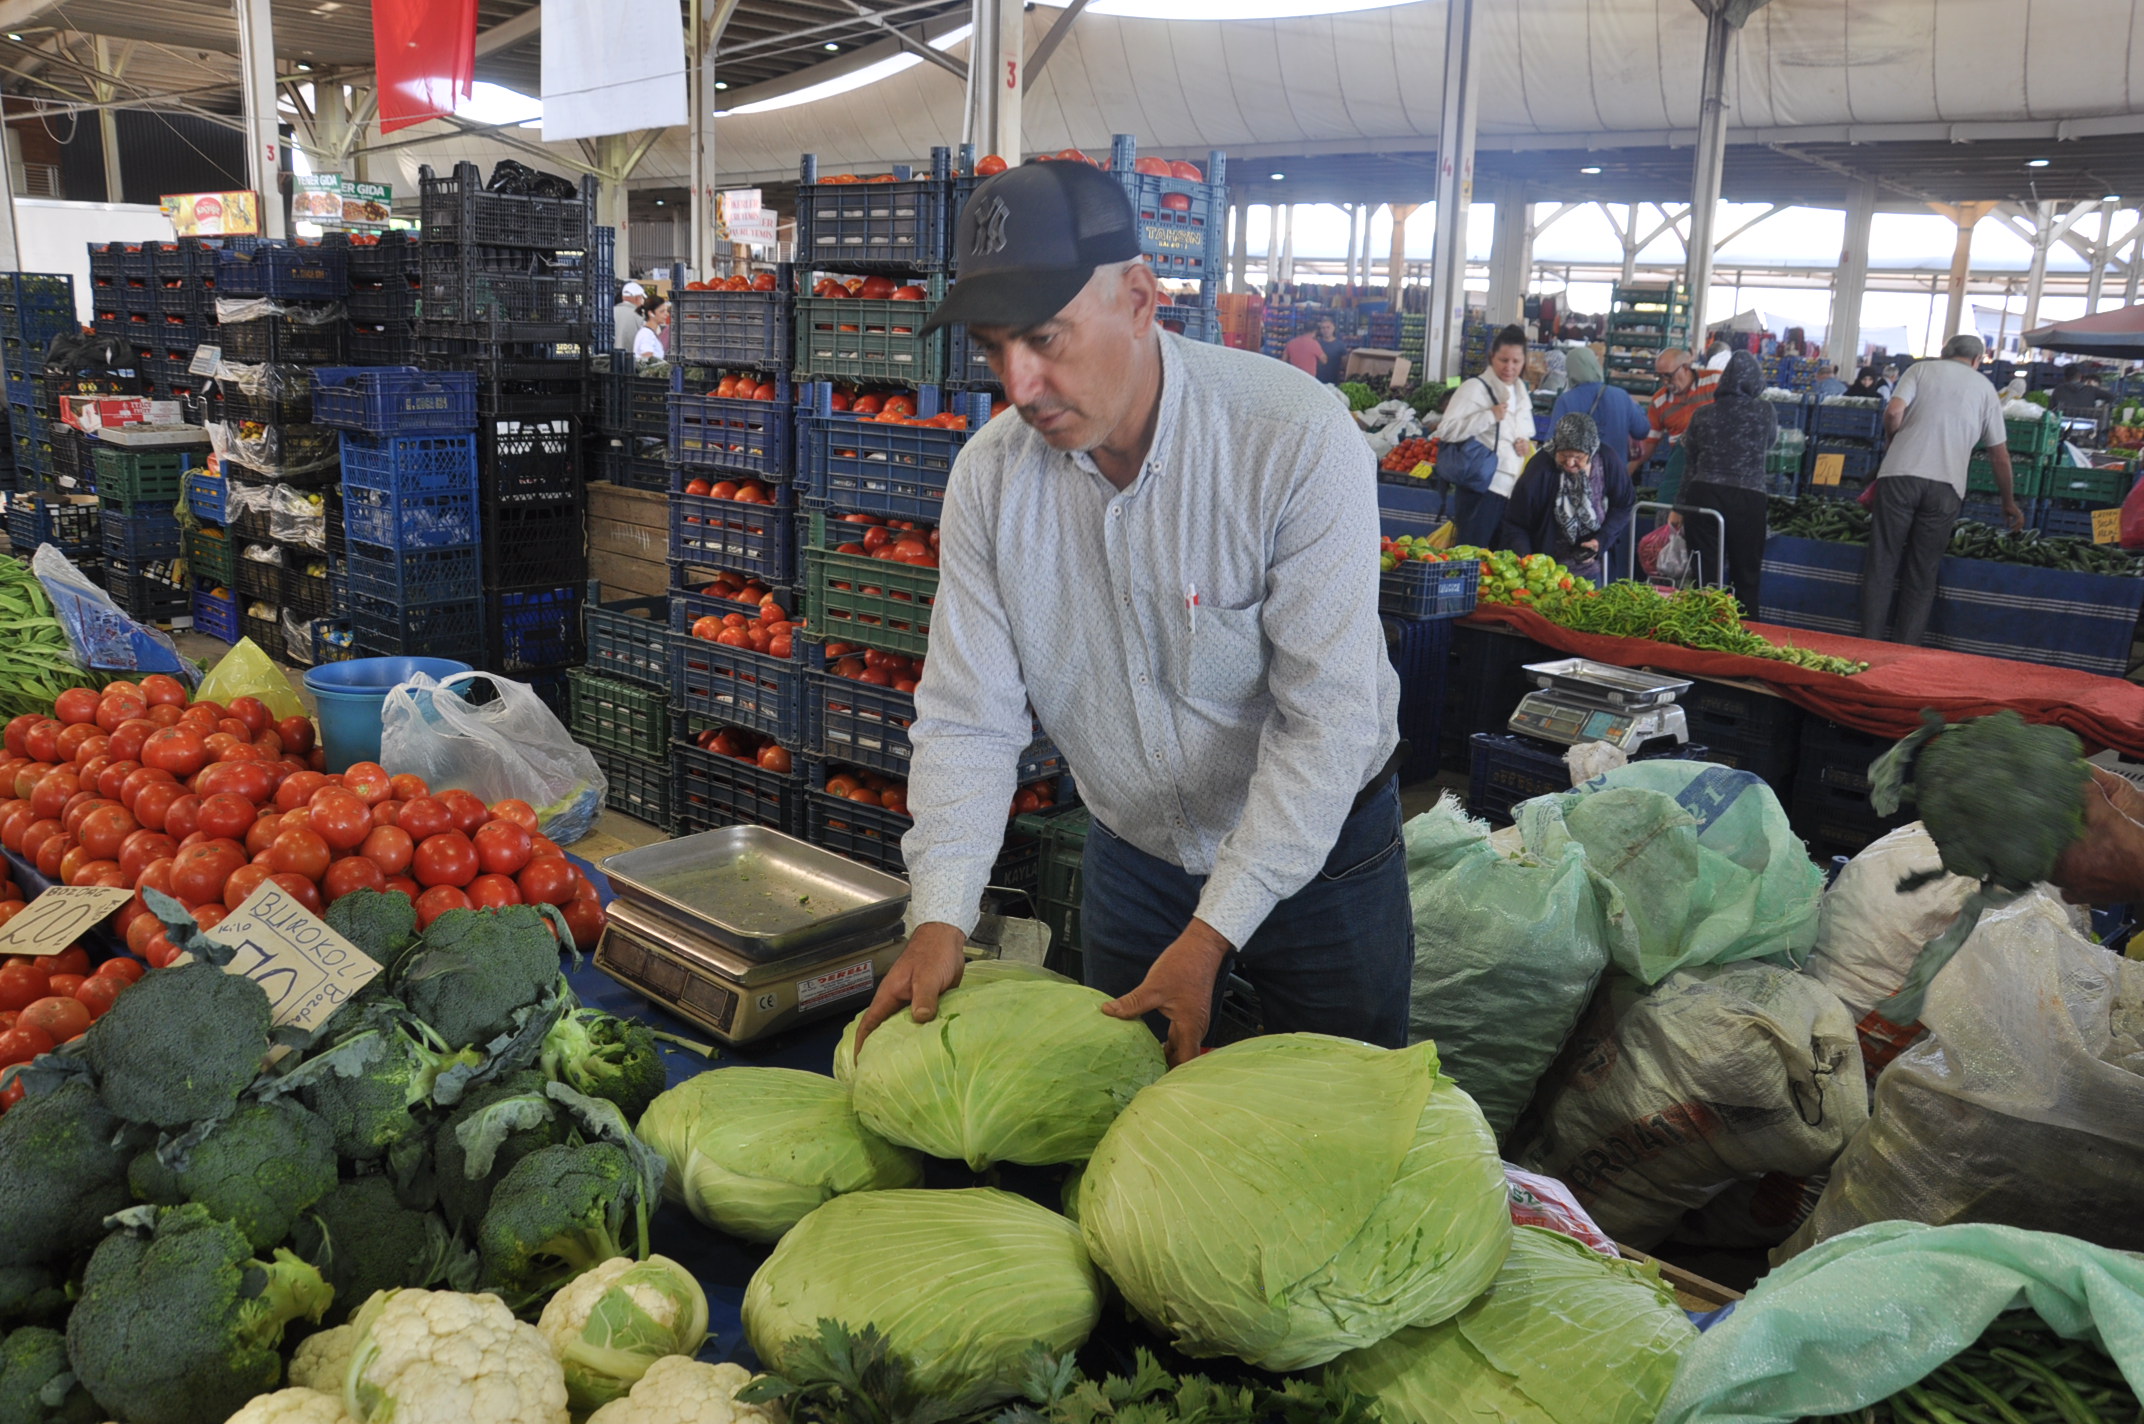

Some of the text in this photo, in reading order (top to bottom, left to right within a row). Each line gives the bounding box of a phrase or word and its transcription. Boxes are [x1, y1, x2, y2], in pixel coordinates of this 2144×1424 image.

[1006, 61, 1017, 89] 3
[266, 144, 275, 162] 3
[357, 184, 385, 196] GIDA
[0, 899, 91, 945] 20
